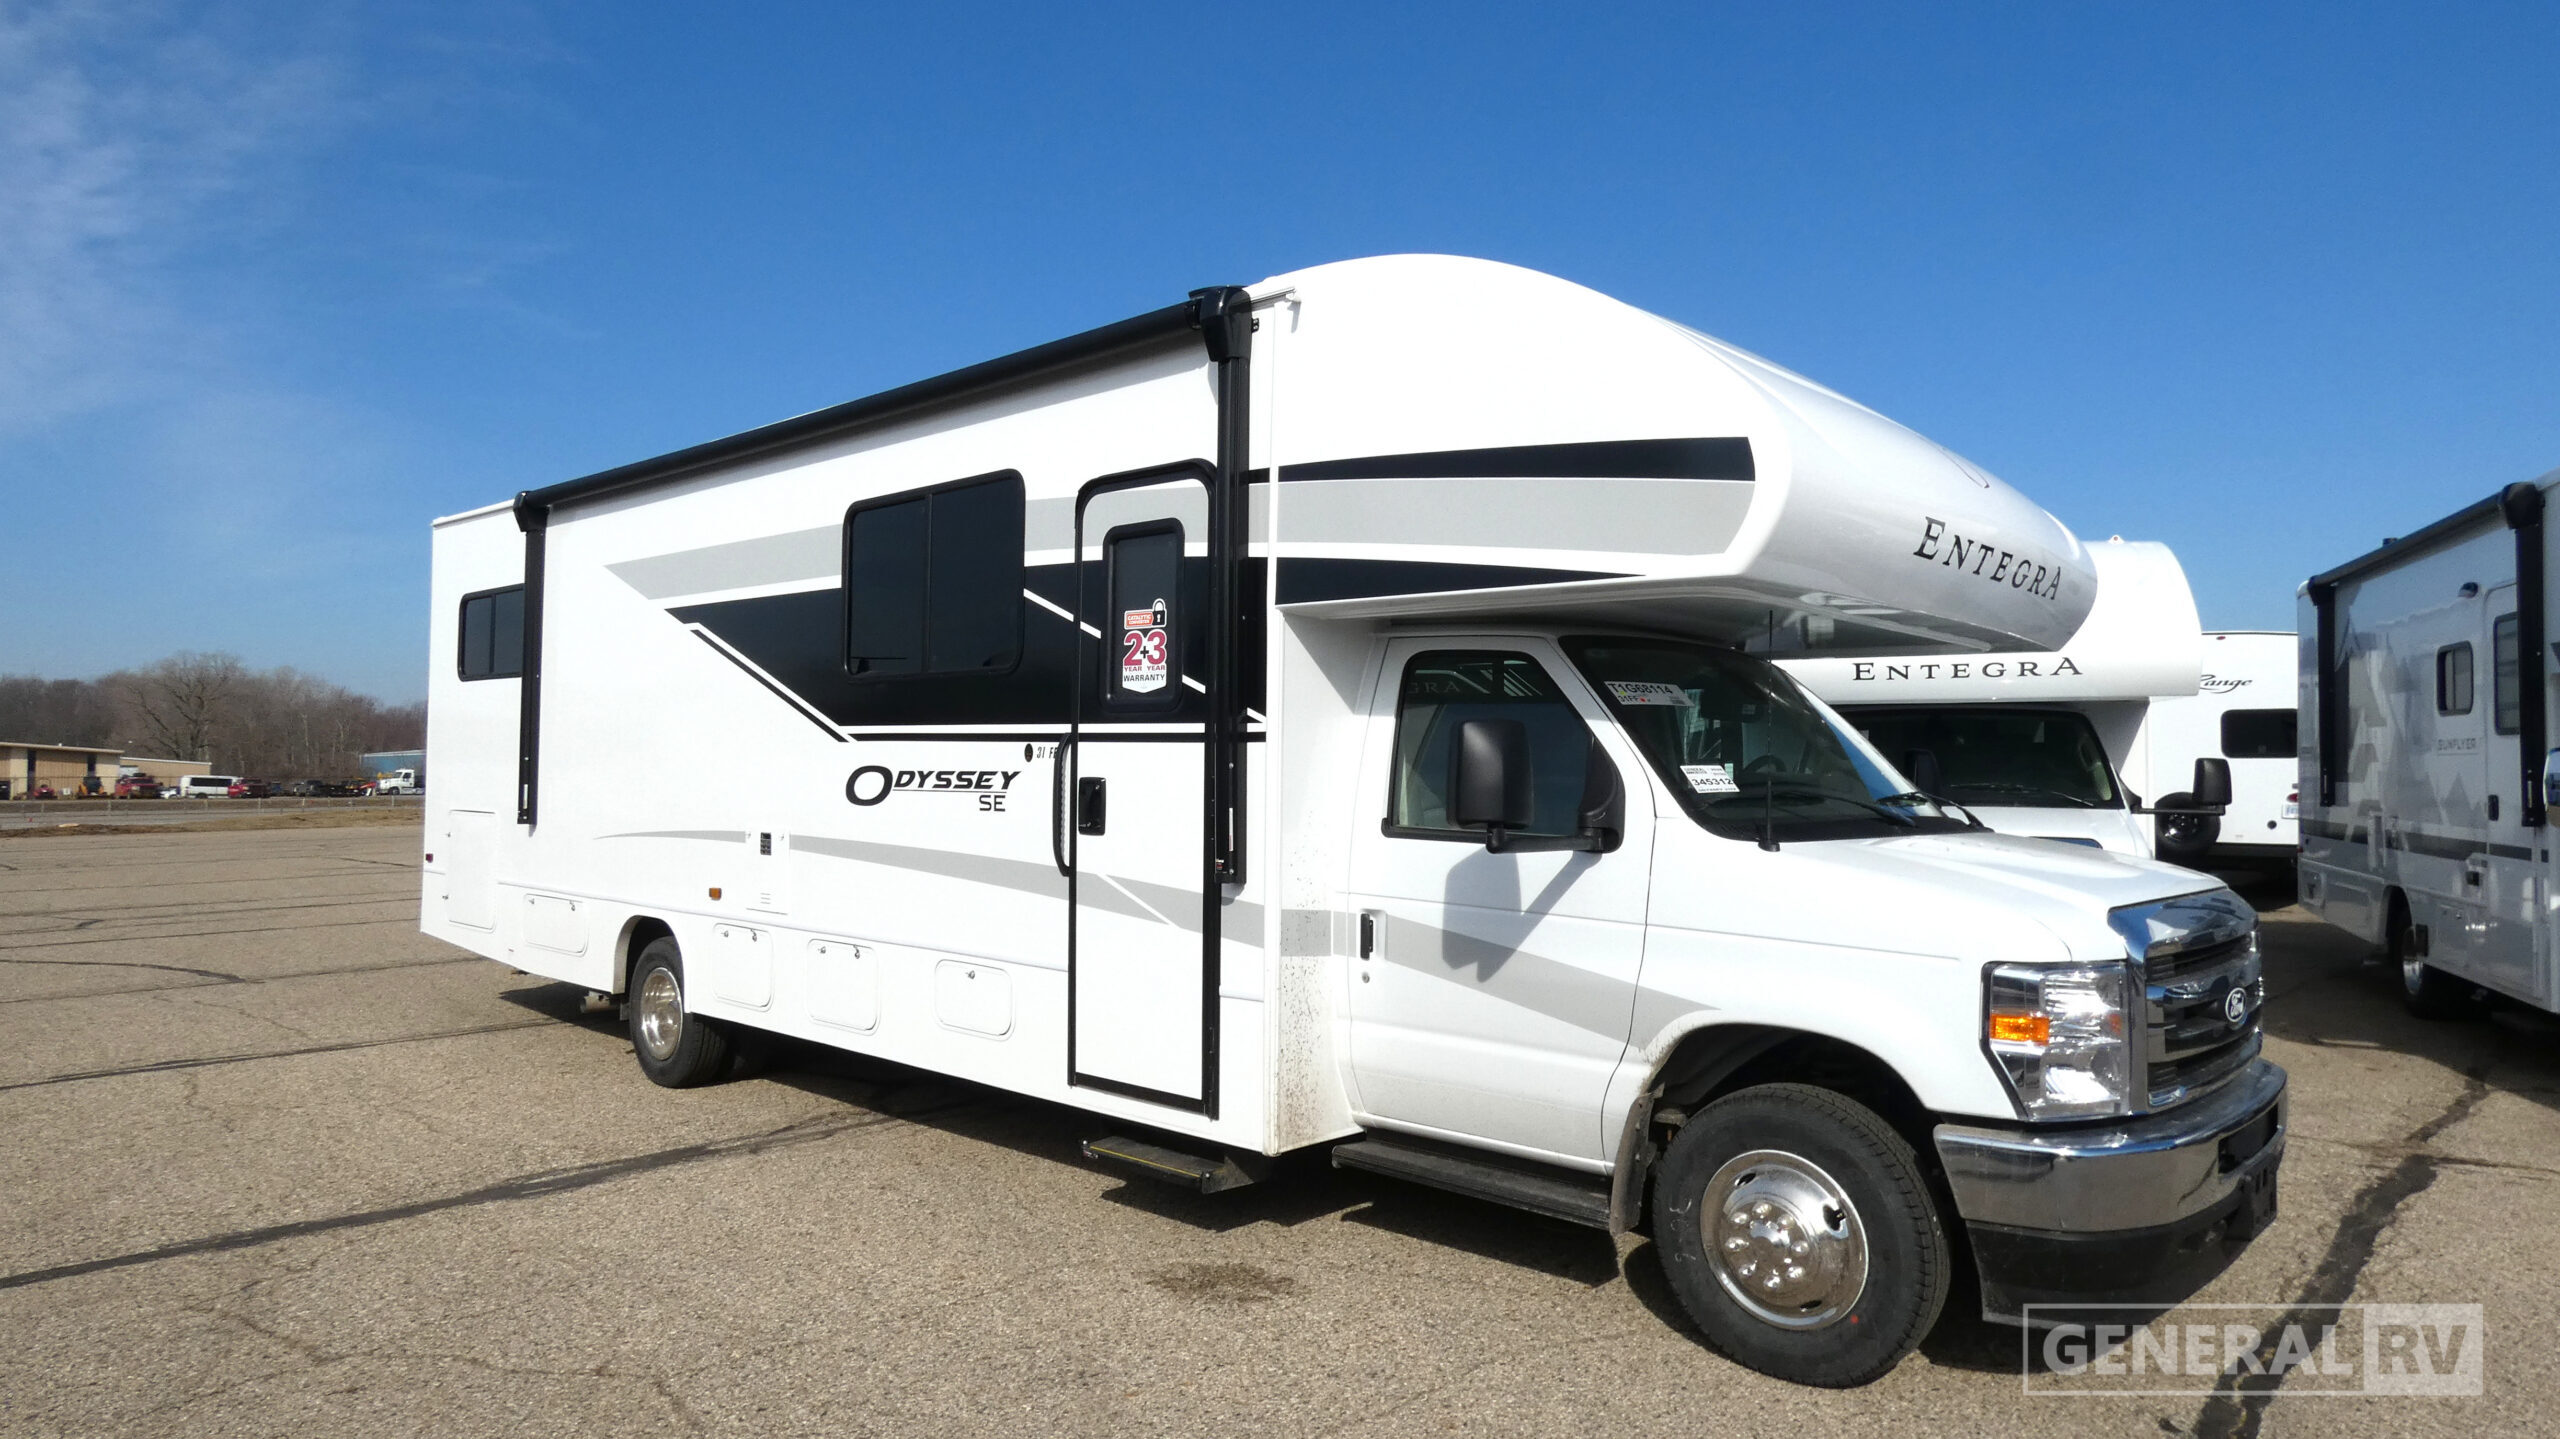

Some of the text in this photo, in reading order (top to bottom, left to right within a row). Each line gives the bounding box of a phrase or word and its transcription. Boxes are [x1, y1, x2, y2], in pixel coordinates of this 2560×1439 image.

[1913, 516, 2062, 600] ENTEGRA
[1124, 673, 1165, 682] WARRANTY
[1853, 657, 2083, 681] ENTEGRA
[845, 765, 1022, 807] ODYSSEY
[978, 795, 1006, 812] SE
